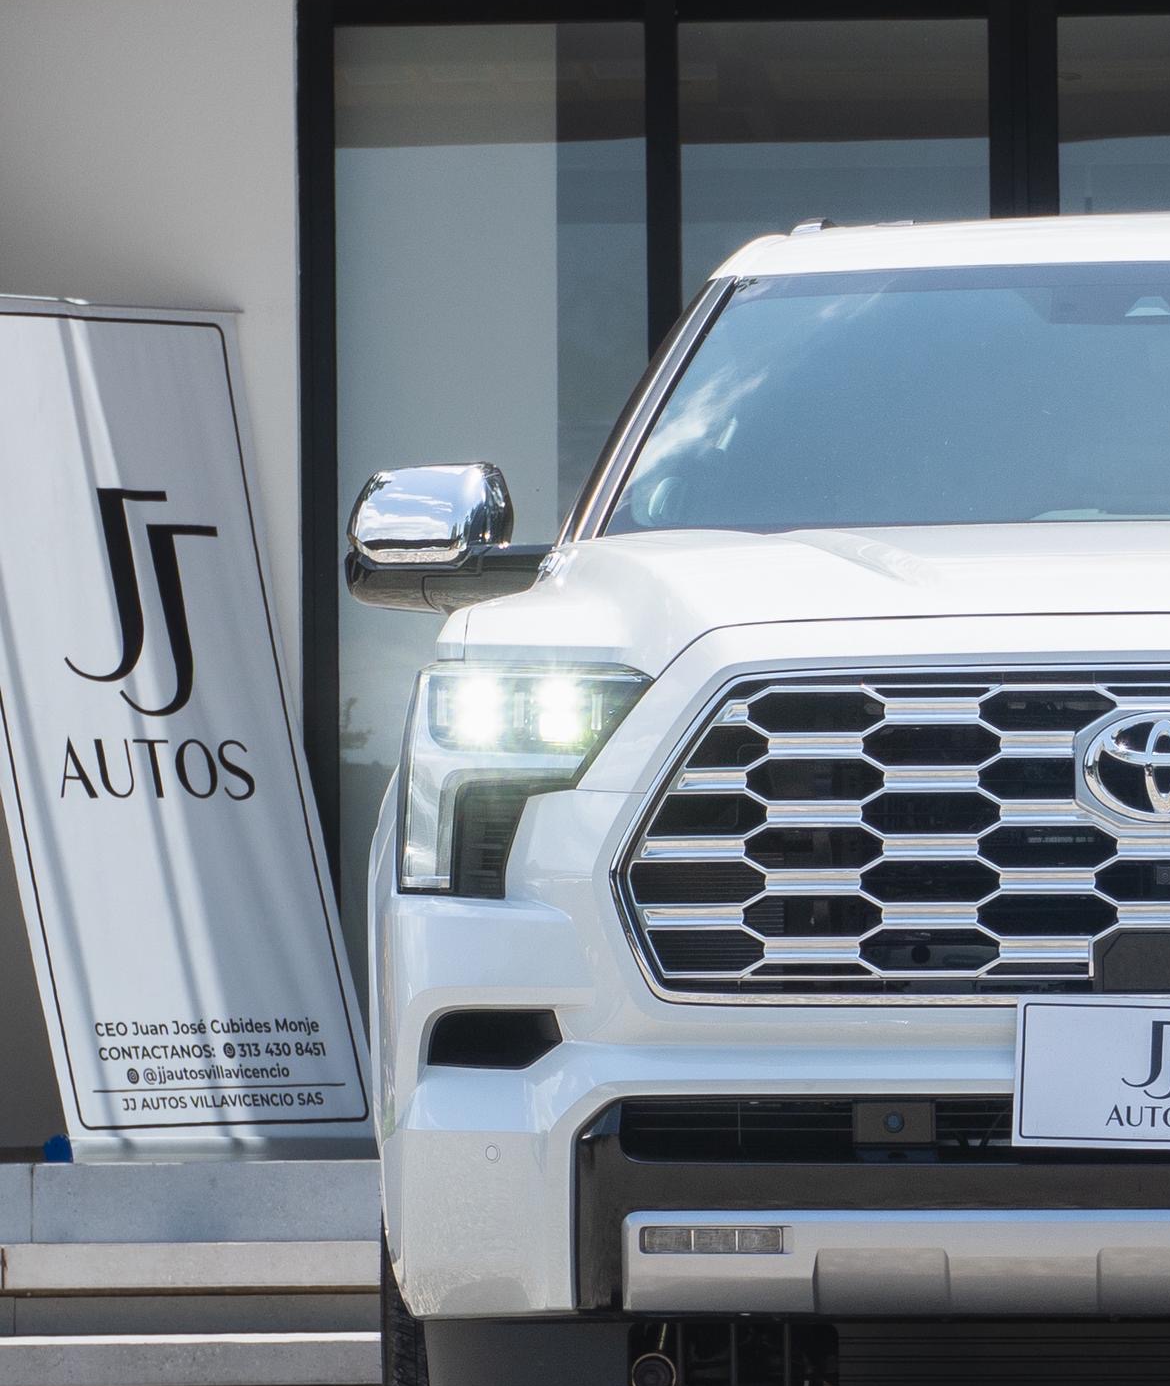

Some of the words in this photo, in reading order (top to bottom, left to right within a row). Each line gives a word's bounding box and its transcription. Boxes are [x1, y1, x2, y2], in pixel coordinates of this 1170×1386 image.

[64, 487, 219, 718] JJ
[60, 735, 257, 802] AUTOS
[94, 1021, 128, 1038] CEO
[131, 1020, 169, 1037] Juan
[172, 1017, 207, 1036] José
[210, 1017, 272, 1035] Cubides
[274, 1016, 320, 1036] Monje
[98, 1043, 217, 1062] CONTACTANOS:
[237, 1041, 262, 1058] 313
[264, 1041, 292, 1058] 430
[294, 1040, 326, 1057] 8451
[142, 1062, 290, 1087] @jjautosvillavicencio
[122, 1097, 137, 1112] JJ
[141, 1095, 188, 1111] AUTOS
[190, 1092, 295, 1110] VILLAVICENCIO
[296, 1091, 325, 1106] SAS
